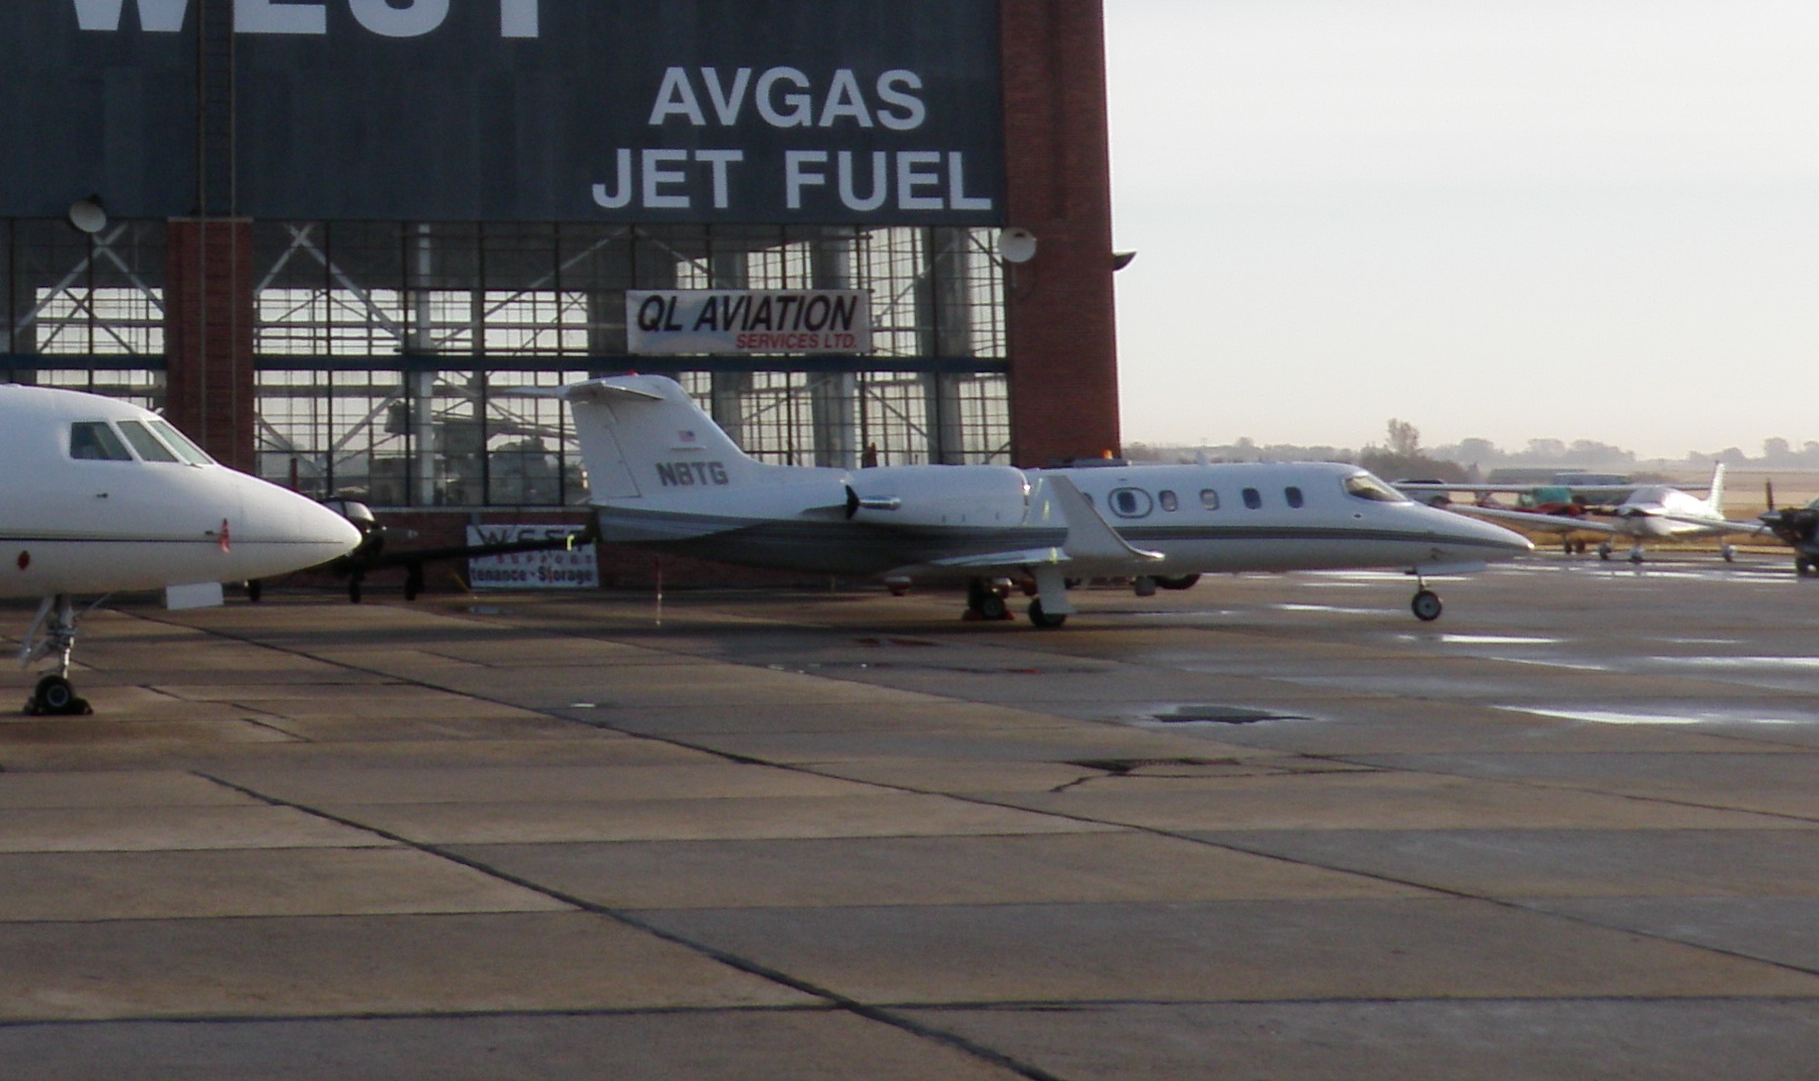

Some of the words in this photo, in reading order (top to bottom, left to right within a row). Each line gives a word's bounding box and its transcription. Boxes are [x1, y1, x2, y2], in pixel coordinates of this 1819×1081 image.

[648, 66, 926, 130] AVGAS
[591, 148, 744, 209] JET
[784, 150, 993, 211] FUEL
[637, 294, 684, 333] QL
[692, 294, 858, 332] AVIATION
[736, 333, 819, 349] SERVICES
[824, 333, 857, 349] LTD.
